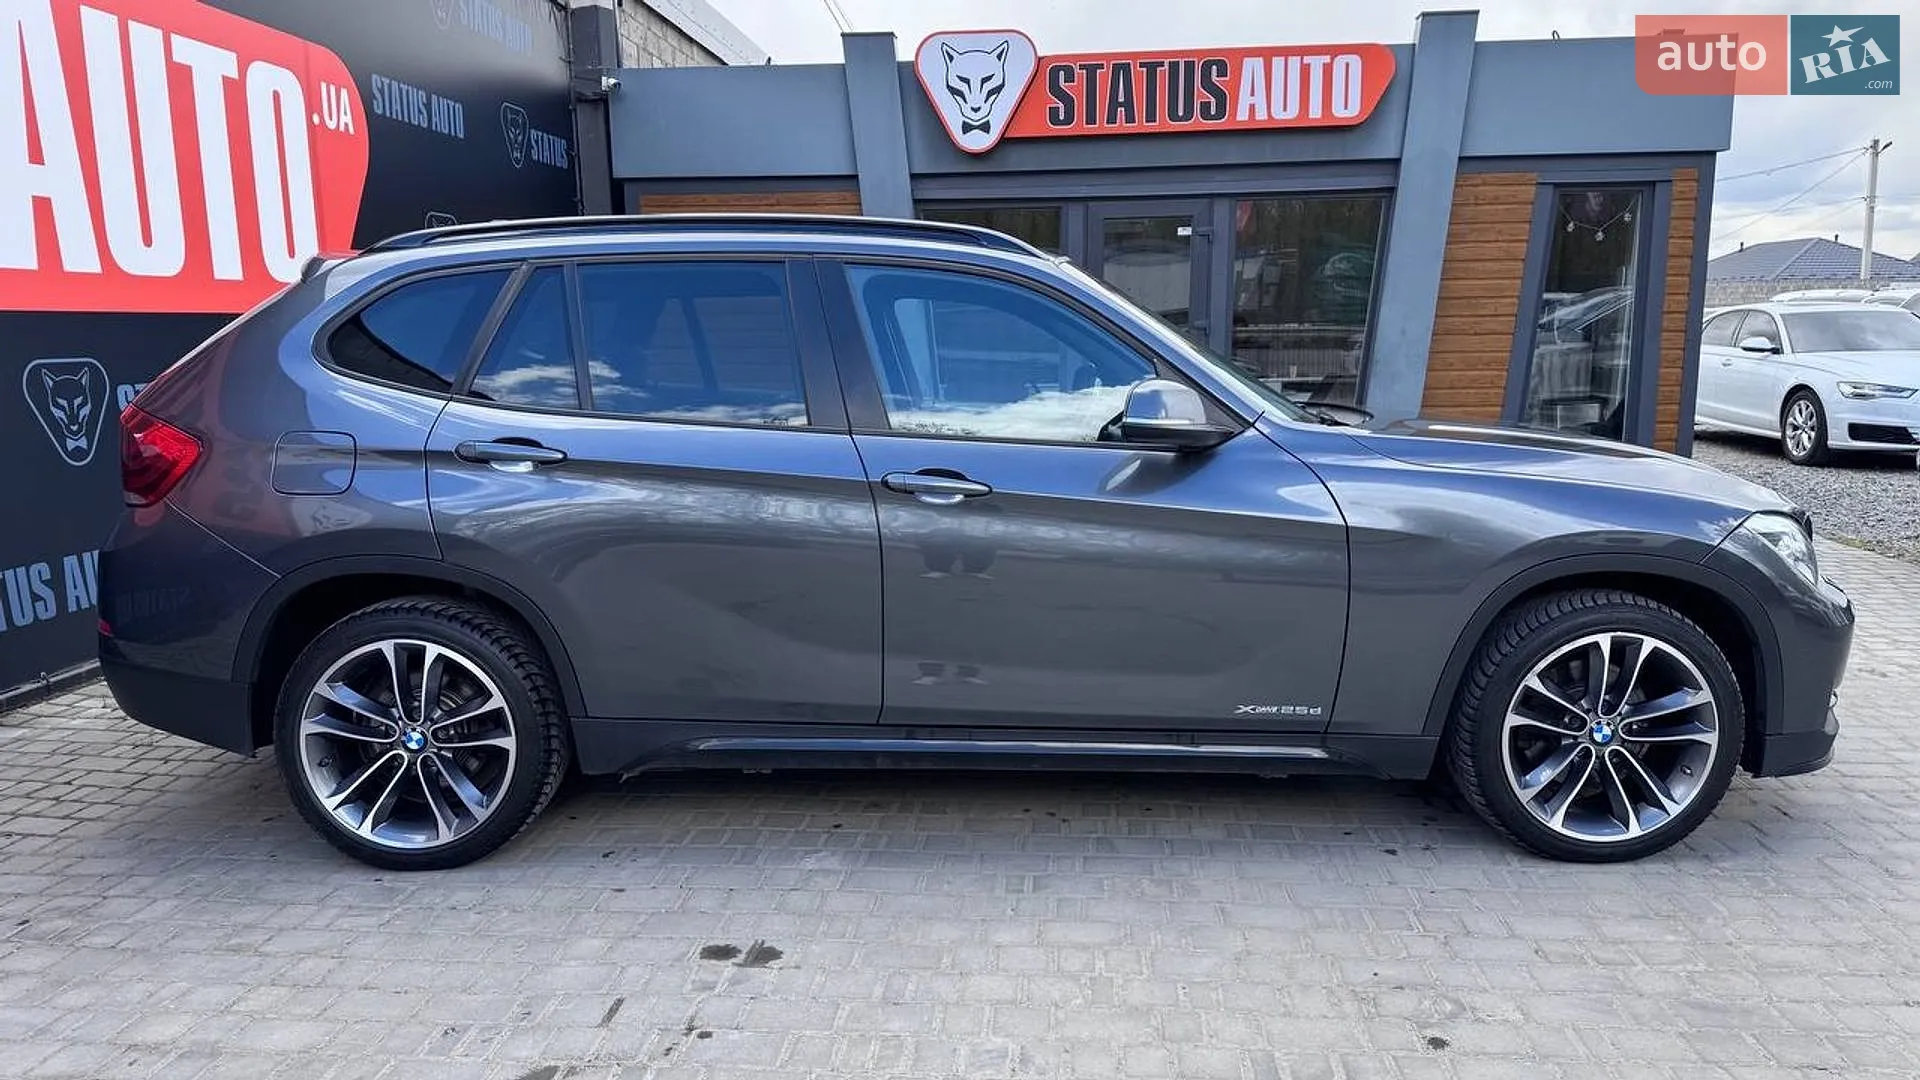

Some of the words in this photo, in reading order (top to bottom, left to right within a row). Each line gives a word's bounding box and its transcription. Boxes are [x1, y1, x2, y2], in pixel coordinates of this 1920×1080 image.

[371, 73, 429, 129] STATUS
[430, 94, 465, 139] AUTO
[1047, 57, 1231, 128] STATUS
[1235, 54, 1363, 122] AUTO
[0, 0, 320, 284] AUTO
[530, 128, 569, 169] STATUS
